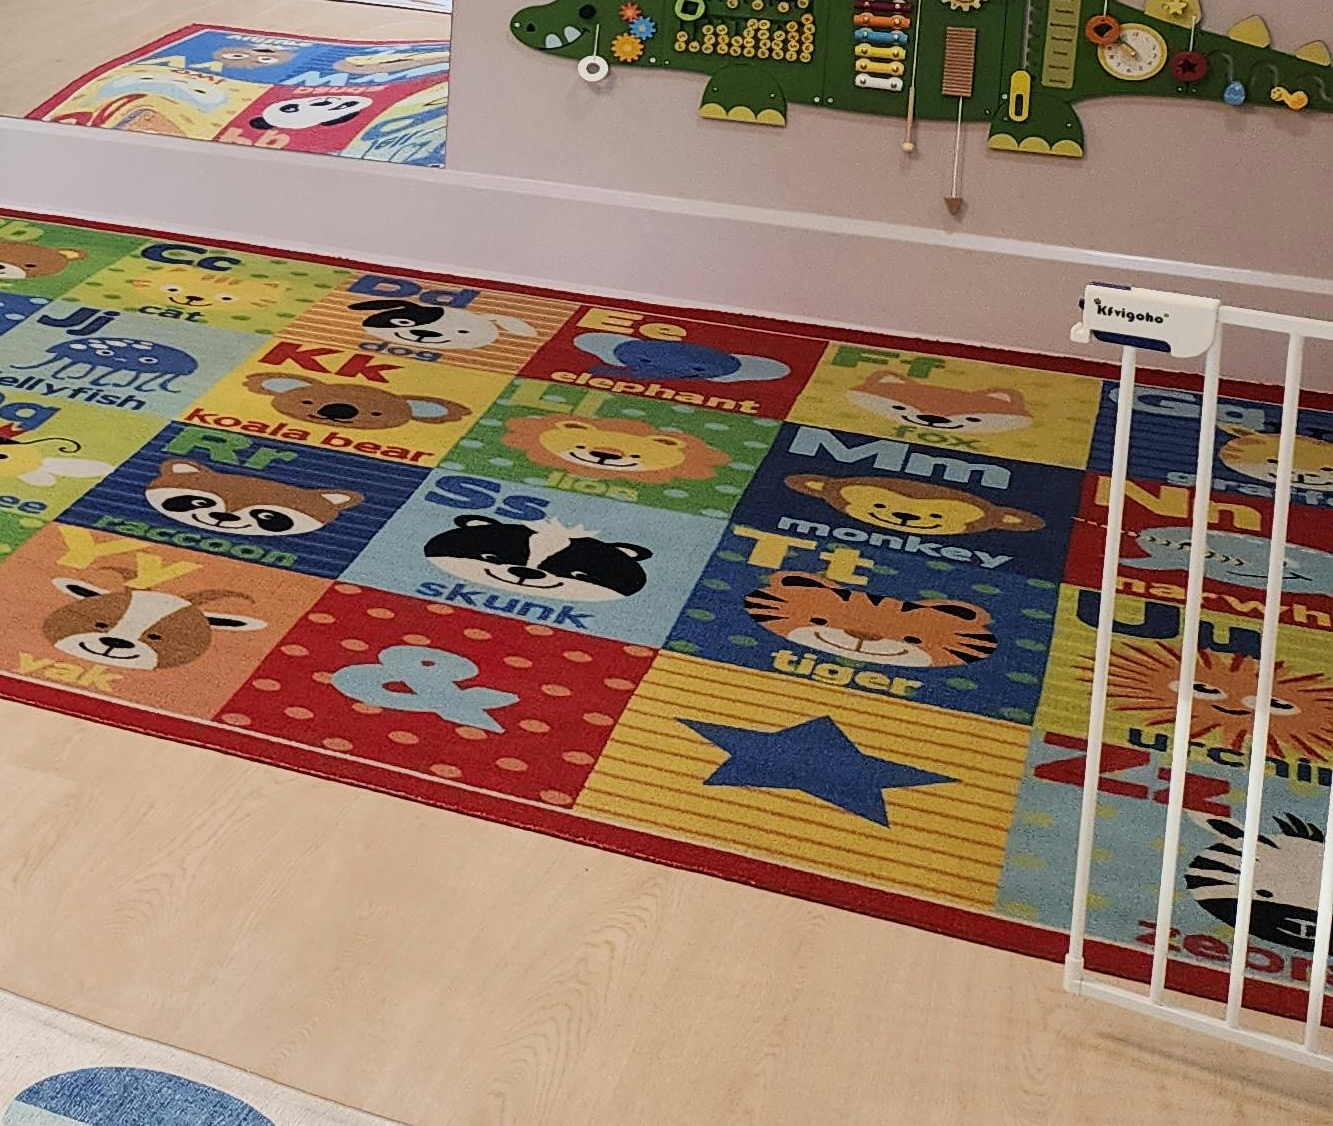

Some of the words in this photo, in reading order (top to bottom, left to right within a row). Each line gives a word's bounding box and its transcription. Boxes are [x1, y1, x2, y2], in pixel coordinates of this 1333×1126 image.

[139, 243, 243, 273] Cc
[345, 275, 481, 308] Dd
[38, 307, 122, 337] Jj
[137, 305, 203, 324] cat
[576, 309, 688, 341] Ee
[1097, 304, 1164, 324] Kfvigoho
[258, 341, 406, 385] Kk
[358, 338, 443, 362] dog
[833, 345, 946, 379] Ff
[550, 369, 760, 417] elephant
[166, 426, 299, 471] Rr
[185, 408, 316, 445] koala
[323, 430, 436, 465] bear
[789, 427, 1014, 490] Mm
[890, 424, 983, 449] fox
[423, 475, 550, 522] Ss
[546, 471, 640, 501] lion
[56, 526, 205, 590] Yy
[90, 514, 297, 568] raccoon
[733, 525, 876, 587] Tt
[777, 517, 1014, 569] monkey
[414, 581, 596, 631] skunk
[17, 651, 125, 691] yak
[770, 648, 924, 698] tiger
